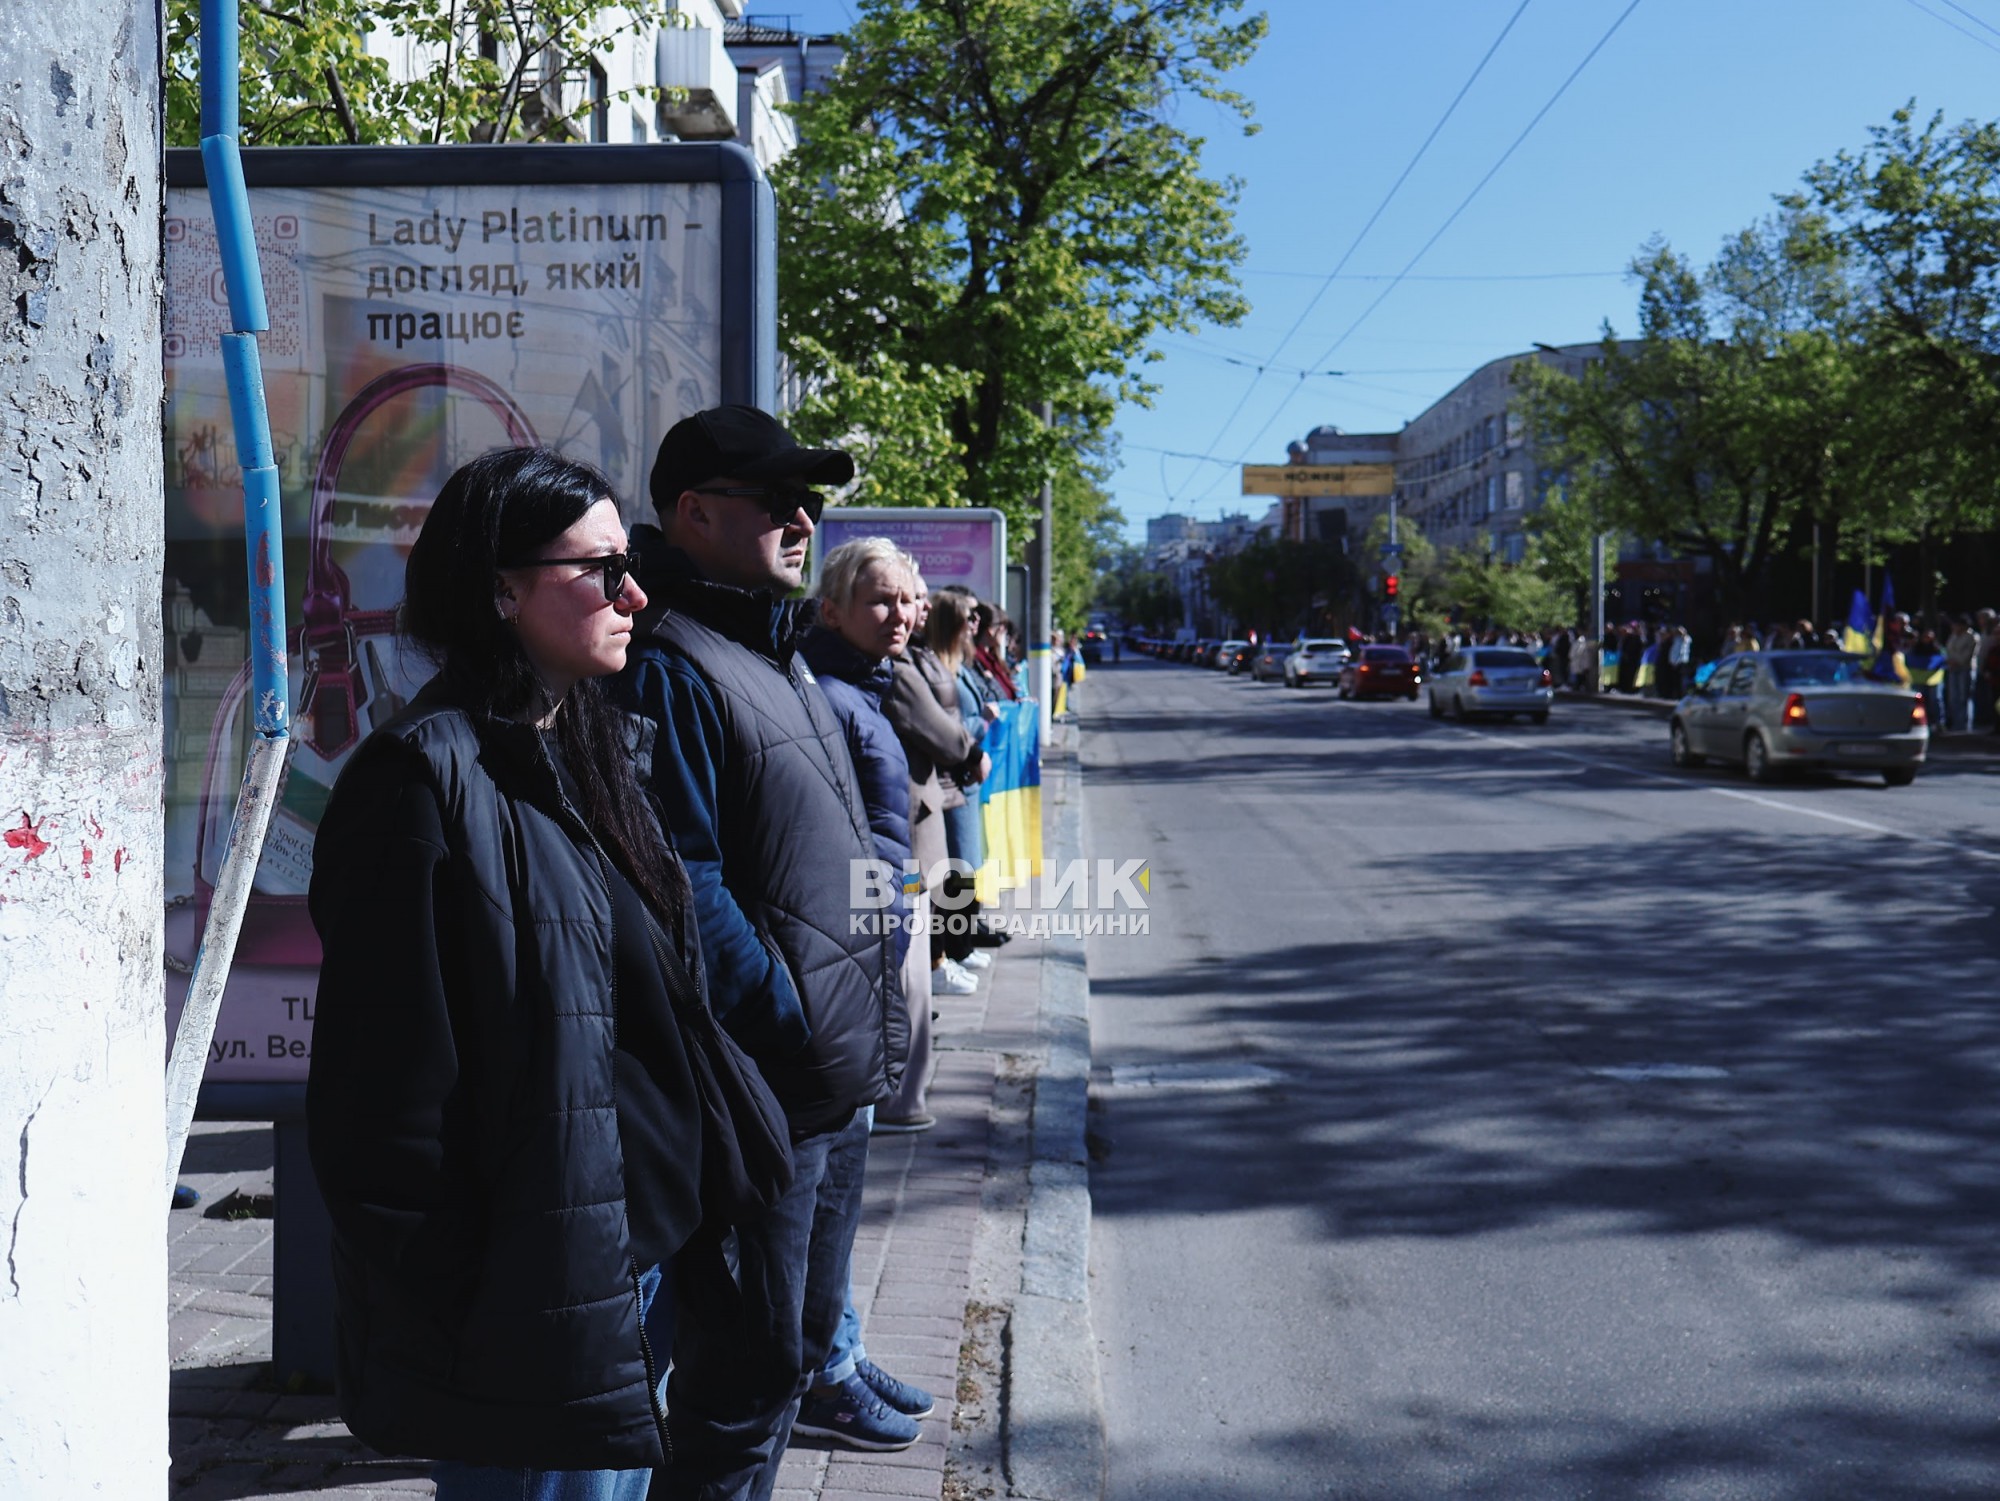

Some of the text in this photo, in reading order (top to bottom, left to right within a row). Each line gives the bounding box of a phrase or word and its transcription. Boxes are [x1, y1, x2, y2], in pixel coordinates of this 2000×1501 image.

[369, 209, 467, 254] Lady
[482, 207, 668, 245] Platinum
[366, 253, 642, 298] догляд, який
[367, 309, 526, 349] працює
[277, 827, 299, 848] Spot
[208, 1035, 312, 1063] ул. Ве
